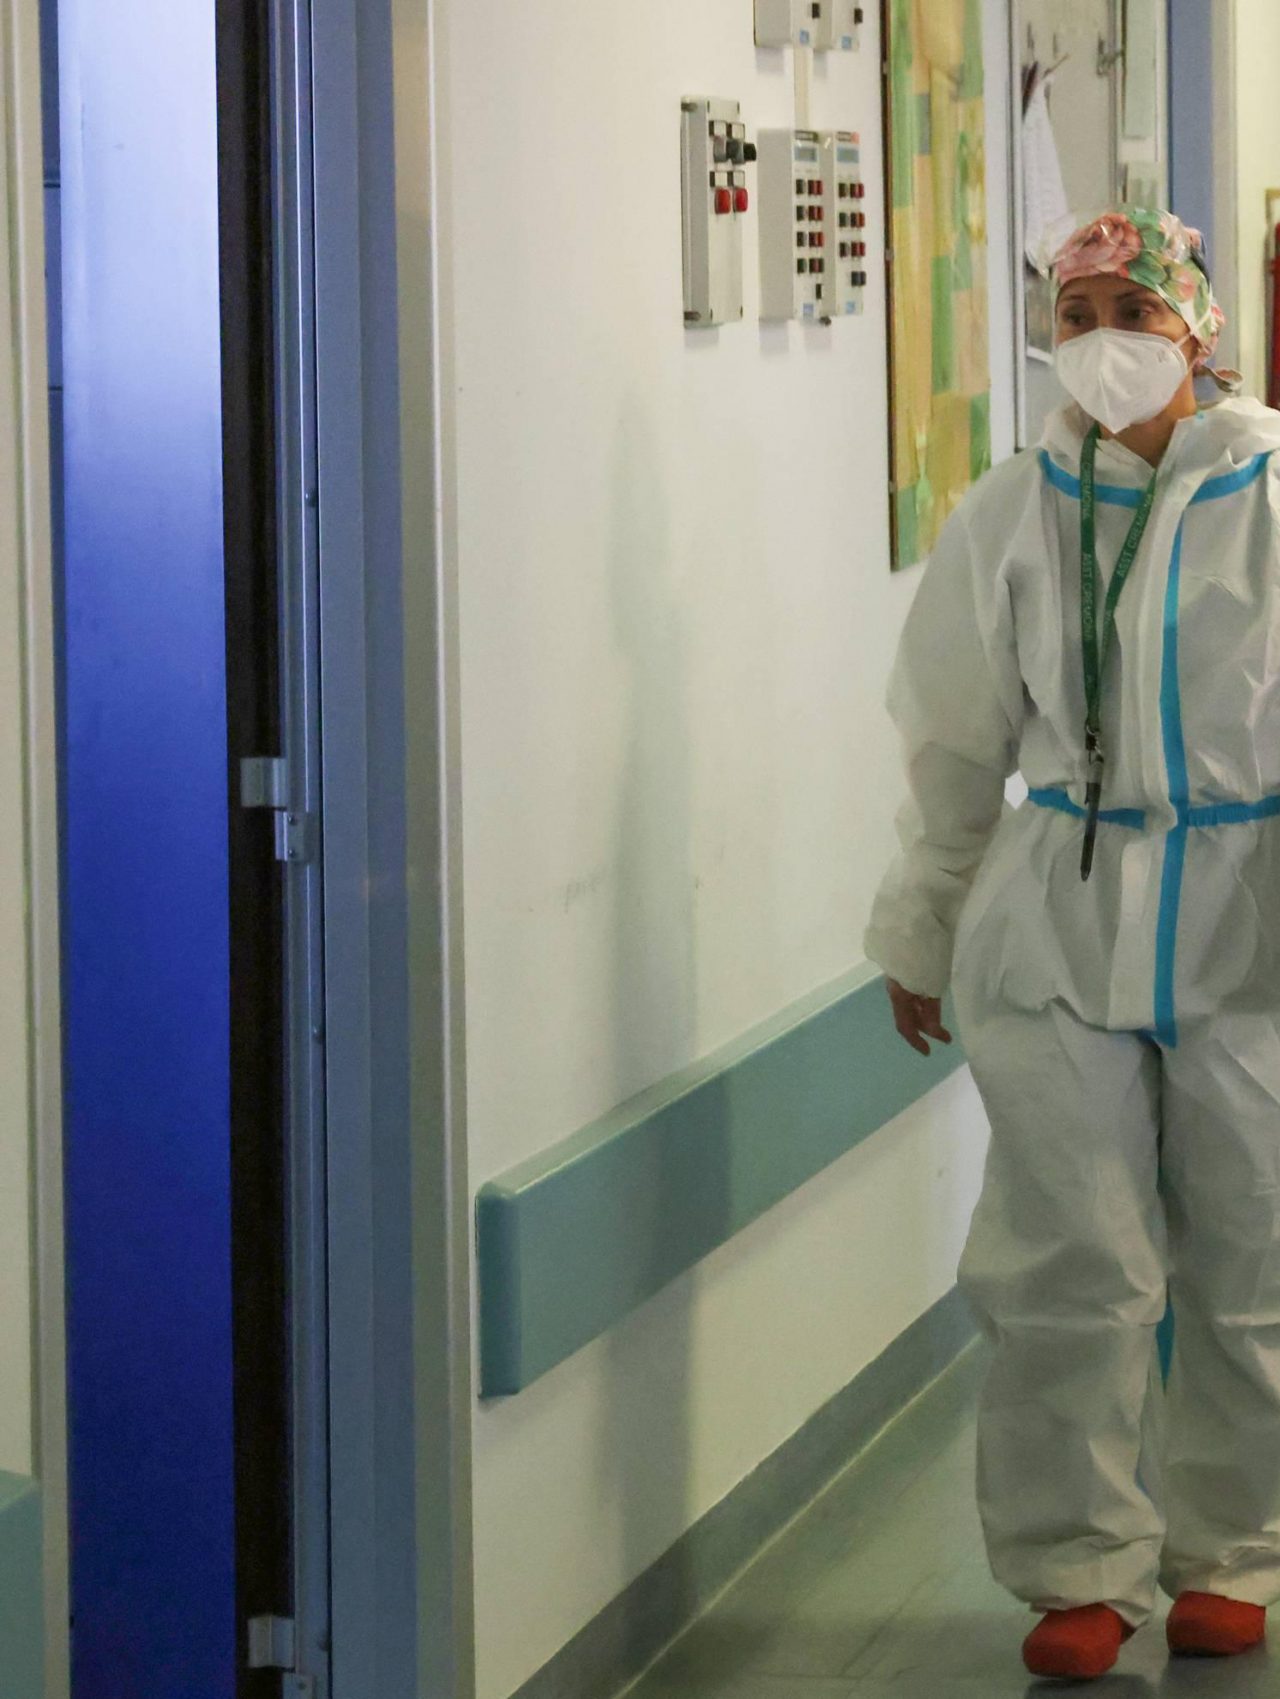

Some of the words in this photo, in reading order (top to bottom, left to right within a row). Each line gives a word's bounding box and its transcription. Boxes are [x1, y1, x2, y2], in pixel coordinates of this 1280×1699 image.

[1082, 552, 1093, 579] ASST
[1116, 550, 1132, 579] ASST
[1082, 583, 1094, 641] CREMONA
